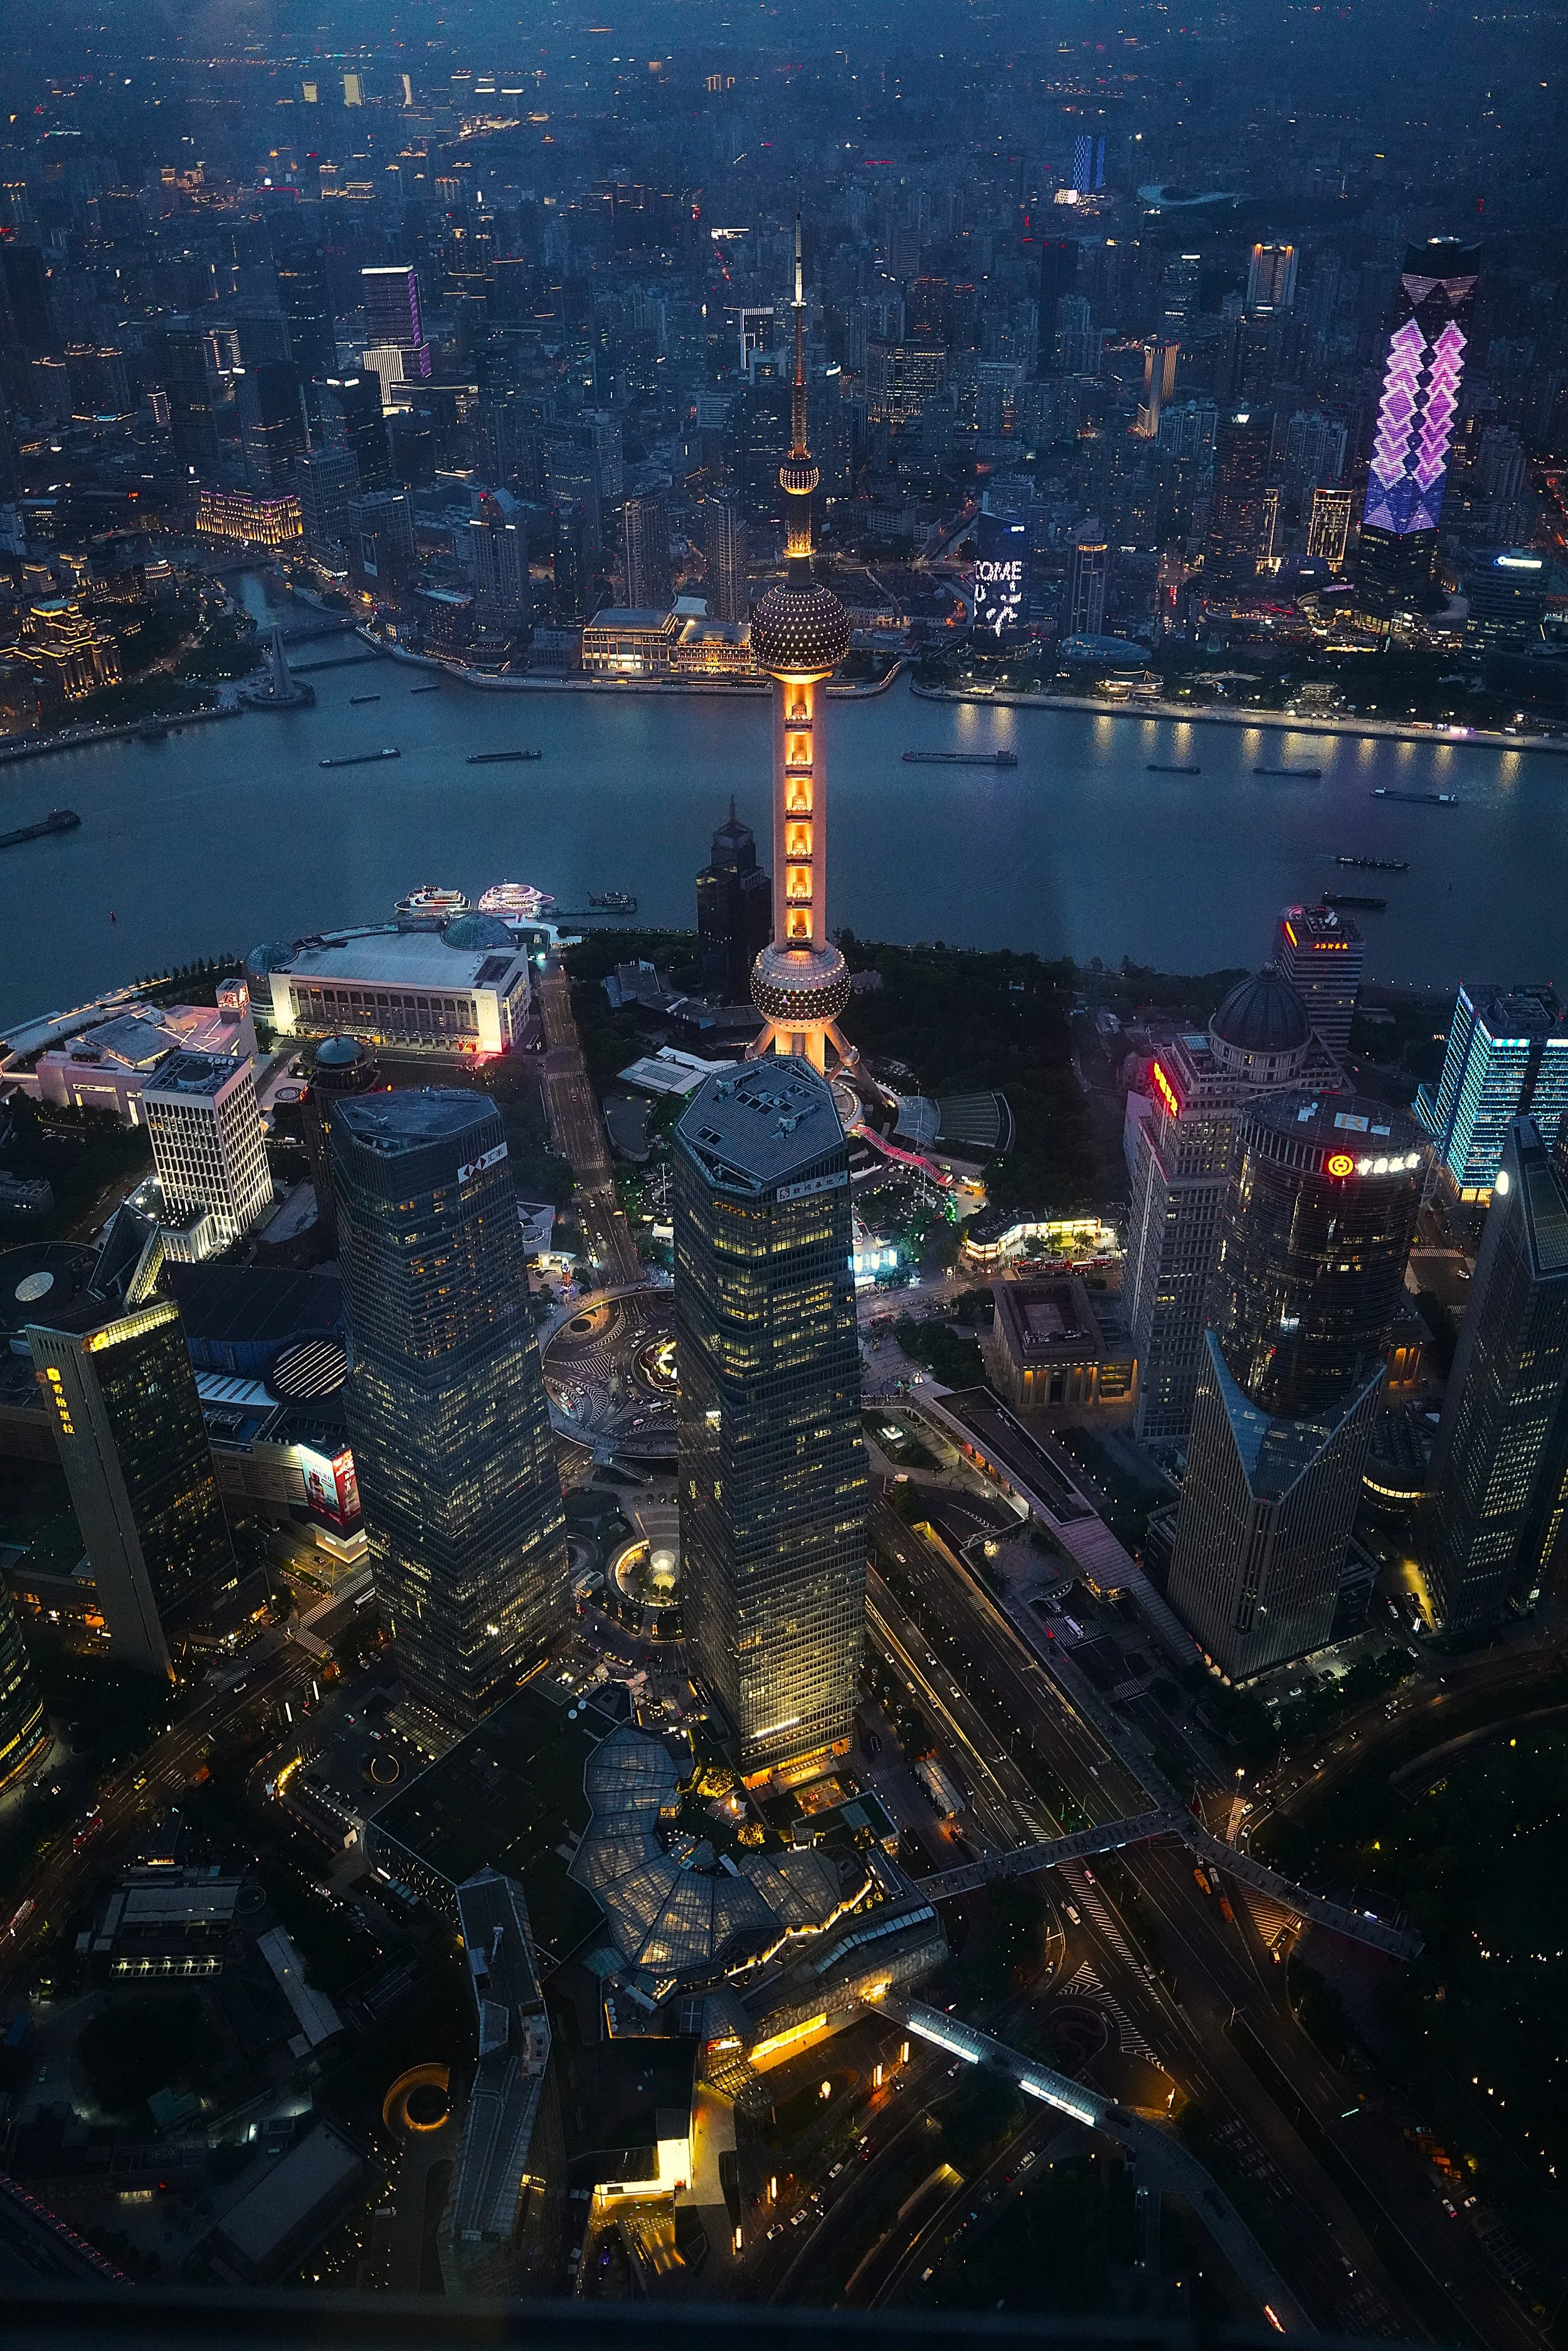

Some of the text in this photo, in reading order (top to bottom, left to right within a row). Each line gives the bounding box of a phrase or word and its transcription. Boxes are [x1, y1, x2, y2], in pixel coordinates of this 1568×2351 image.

[488, 1148, 502, 1163] 汇丰
[51, 1384, 75, 1434] 香格里拉
